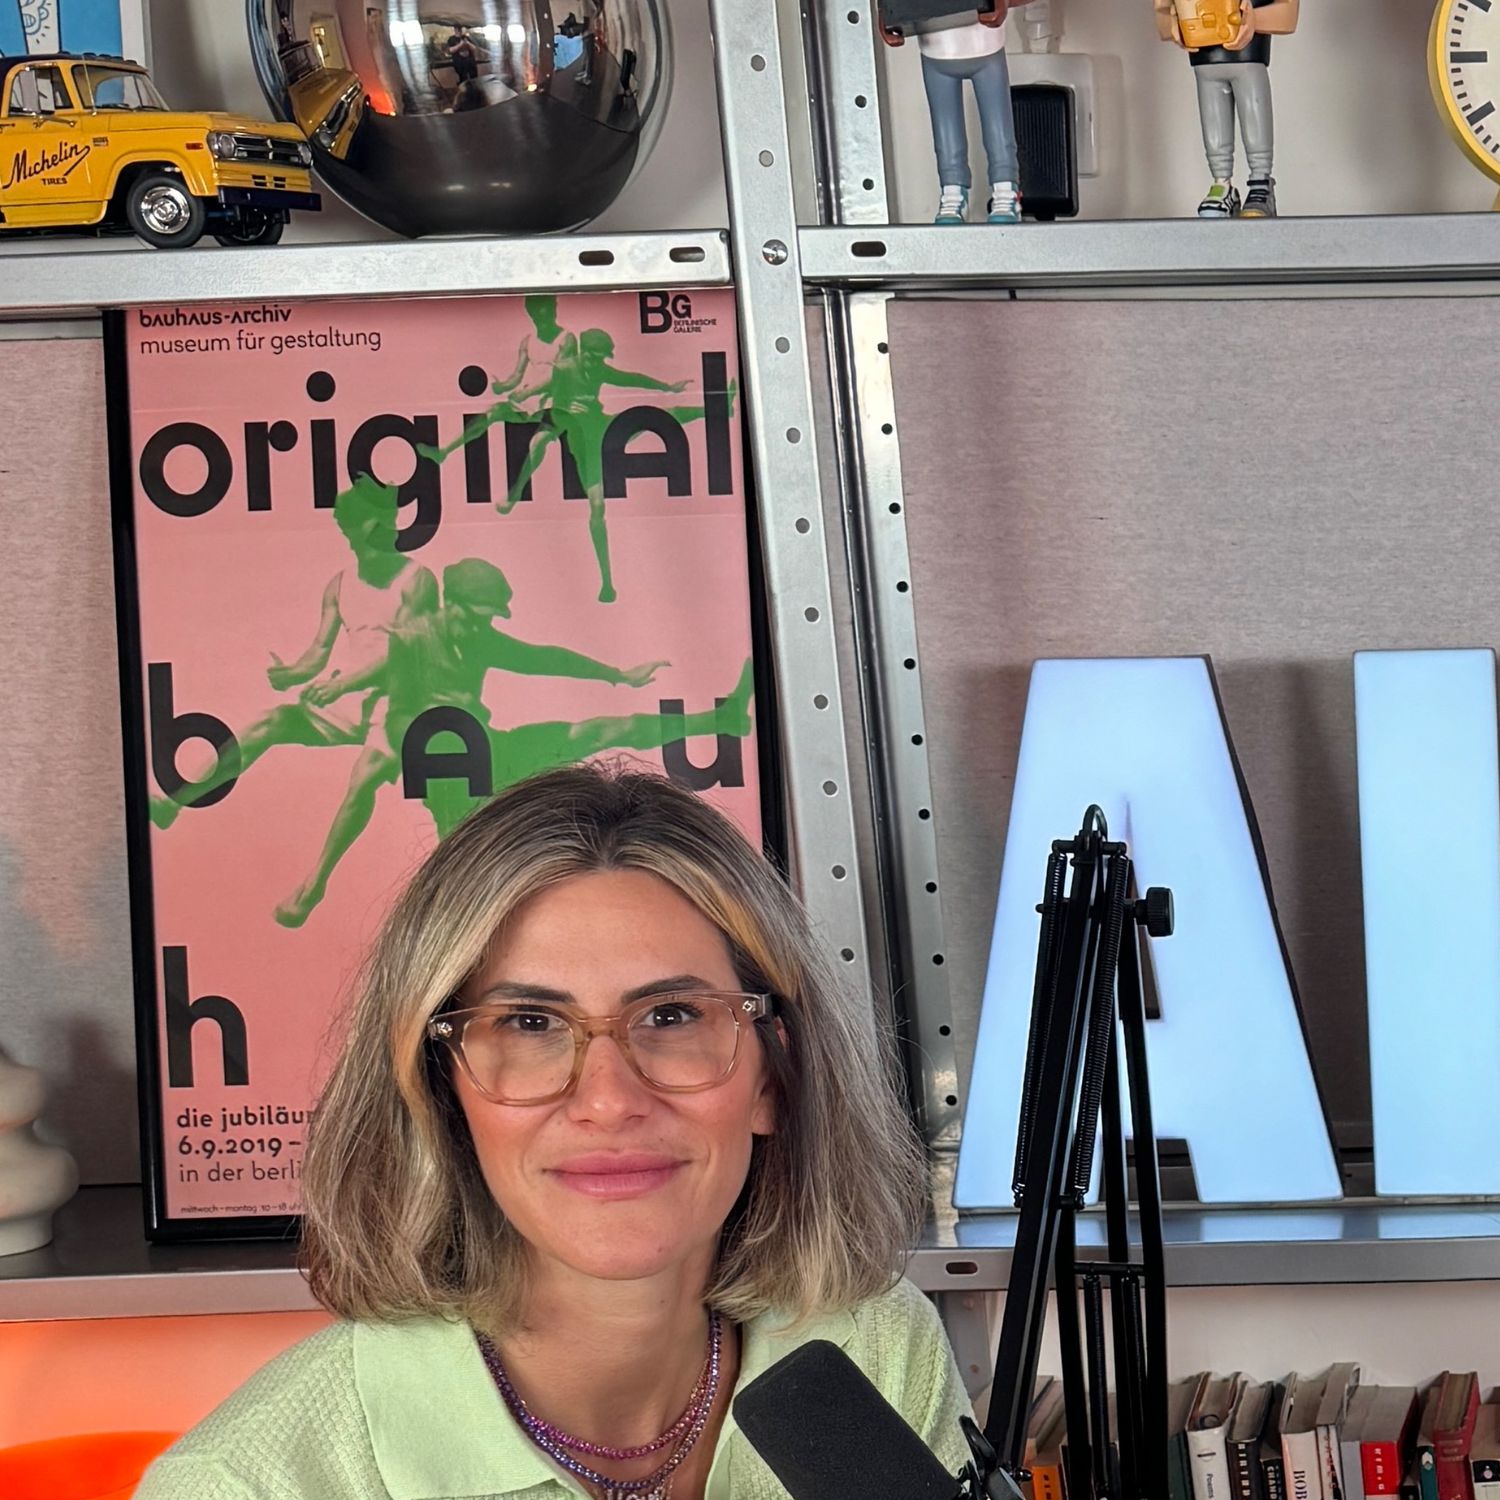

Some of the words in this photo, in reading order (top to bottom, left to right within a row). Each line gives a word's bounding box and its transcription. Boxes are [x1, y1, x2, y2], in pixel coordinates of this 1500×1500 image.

[3, 142, 91, 189] Michelin
[41, 177, 68, 186] TIRES
[139, 304, 292, 327] bauhaus-archiv
[639, 290, 692, 334] BG
[140, 338, 230, 354] museum
[237, 329, 265, 351] für
[270, 326, 382, 355] gestaltung
[138, 351, 734, 552] original
[177, 1108, 213, 1128] die
[178, 1135, 282, 1159] 6.9.2019
[179, 1164, 199, 1182] in
[208, 1162, 244, 1182] der
[1206, 1473, 1215, 1499] Poems
[1293, 1470, 1307, 1500] BOB
